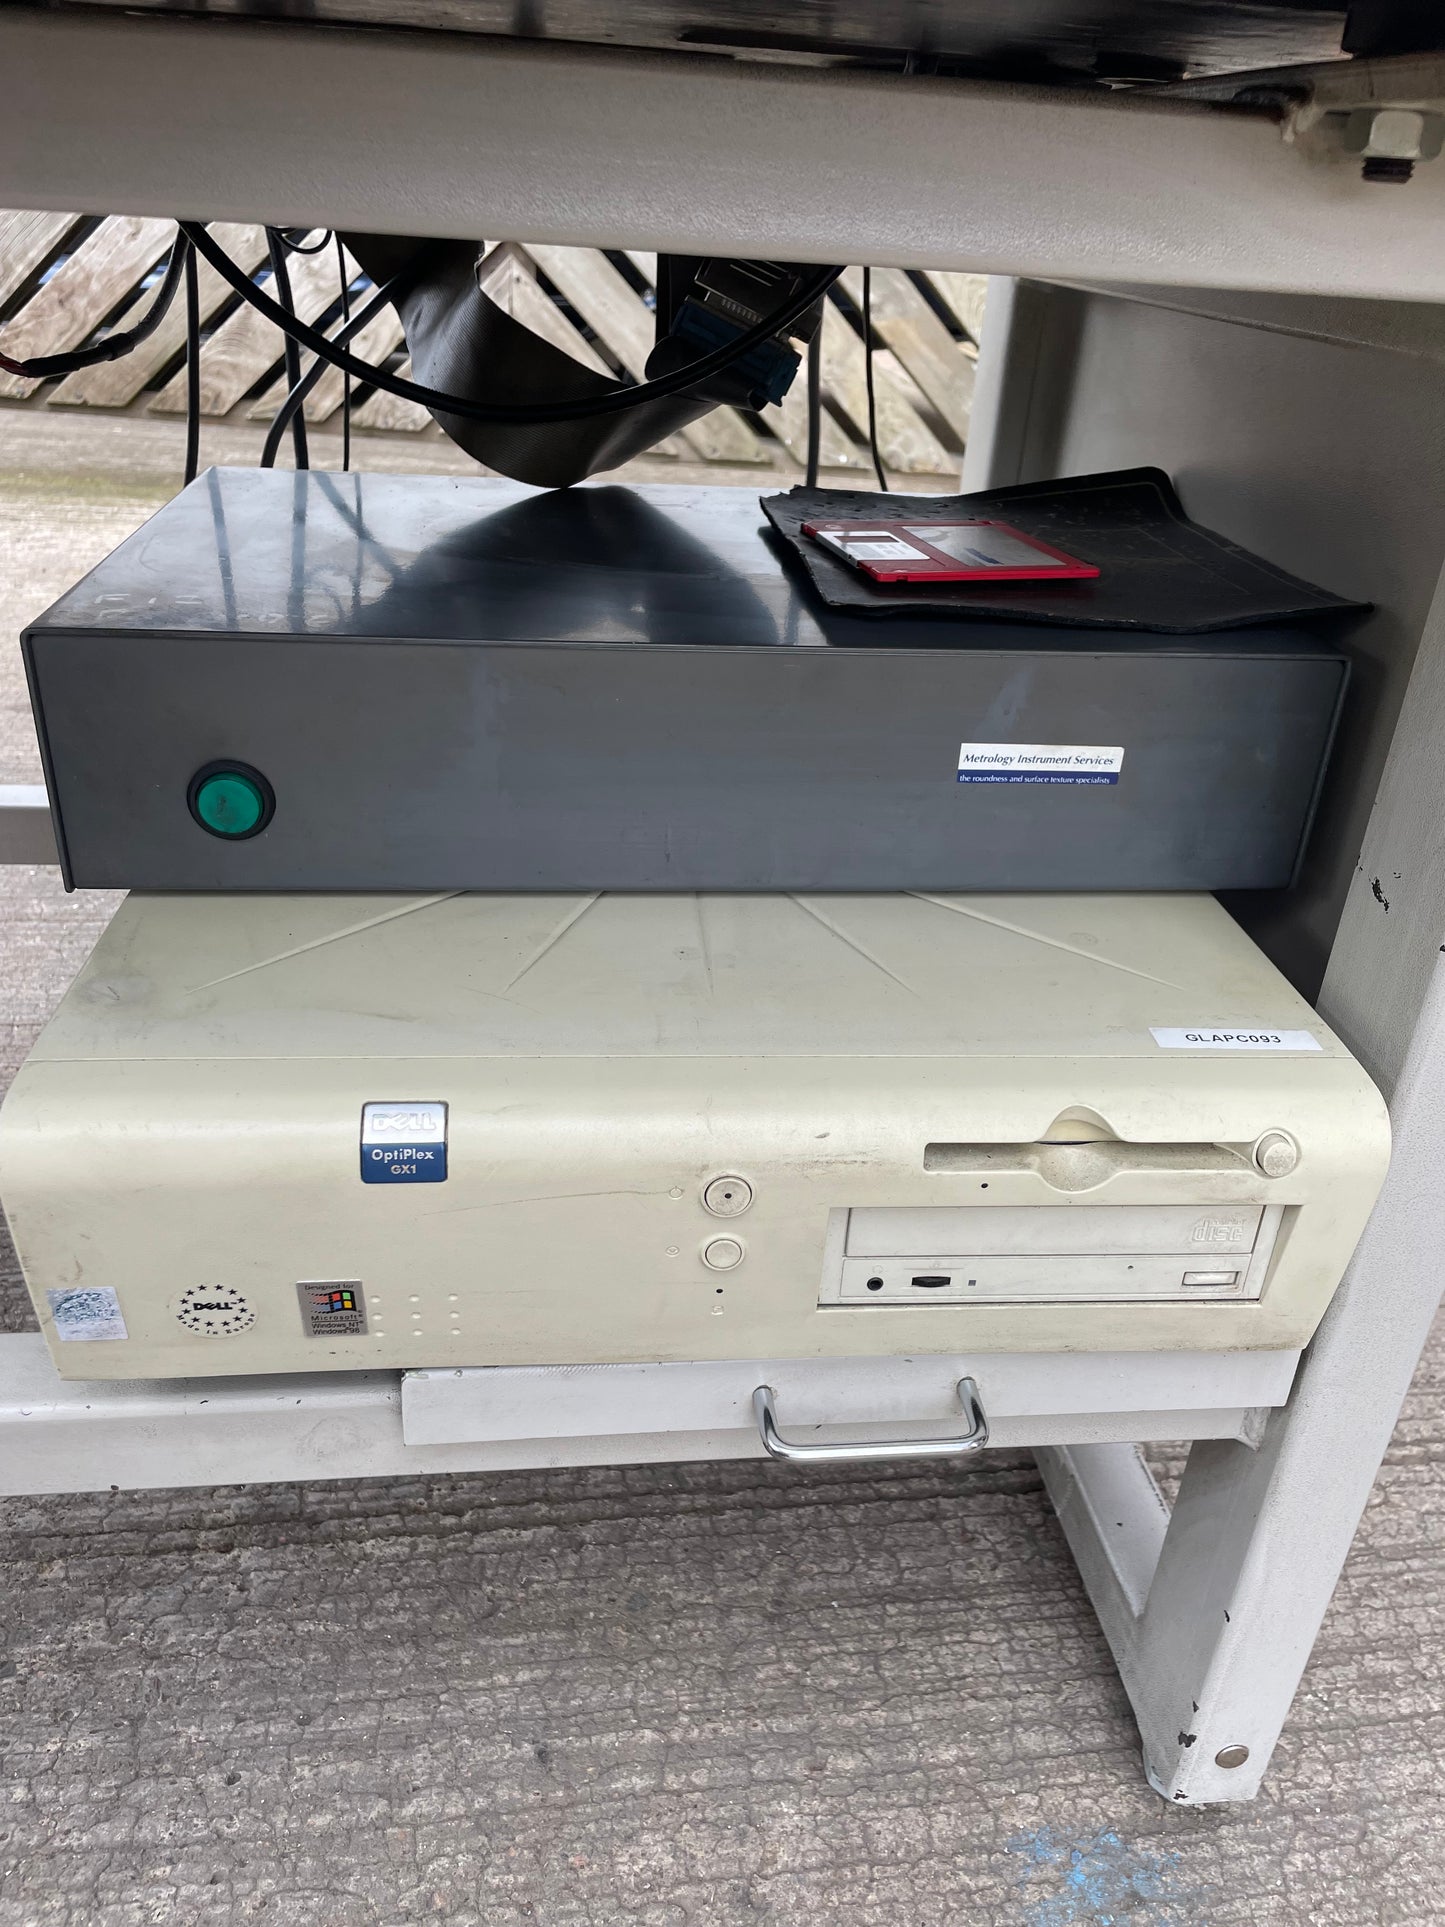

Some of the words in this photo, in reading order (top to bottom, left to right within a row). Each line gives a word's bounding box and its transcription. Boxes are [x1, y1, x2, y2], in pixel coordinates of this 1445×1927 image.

[963, 754, 1015, 766] Metrology
[1017, 754, 1071, 765] Instrument
[1073, 755, 1115, 766] Services
[959, 774, 971, 782] the
[972, 775, 1008, 783] roundness
[1009, 775, 1024, 783] and
[1024, 775, 1047, 783] surface
[1050, 776, 1074, 784] texture
[1075, 776, 1111, 785] specialists
[1185, 1033, 1282, 1044] GLAPC093
[372, 1112, 437, 1131] DELL
[371, 1148, 434, 1163] OptiPlex
[390, 1164, 417, 1175] GX1
[1191, 1218, 1244, 1241] disc
[193, 1302, 233, 1311] DELL
